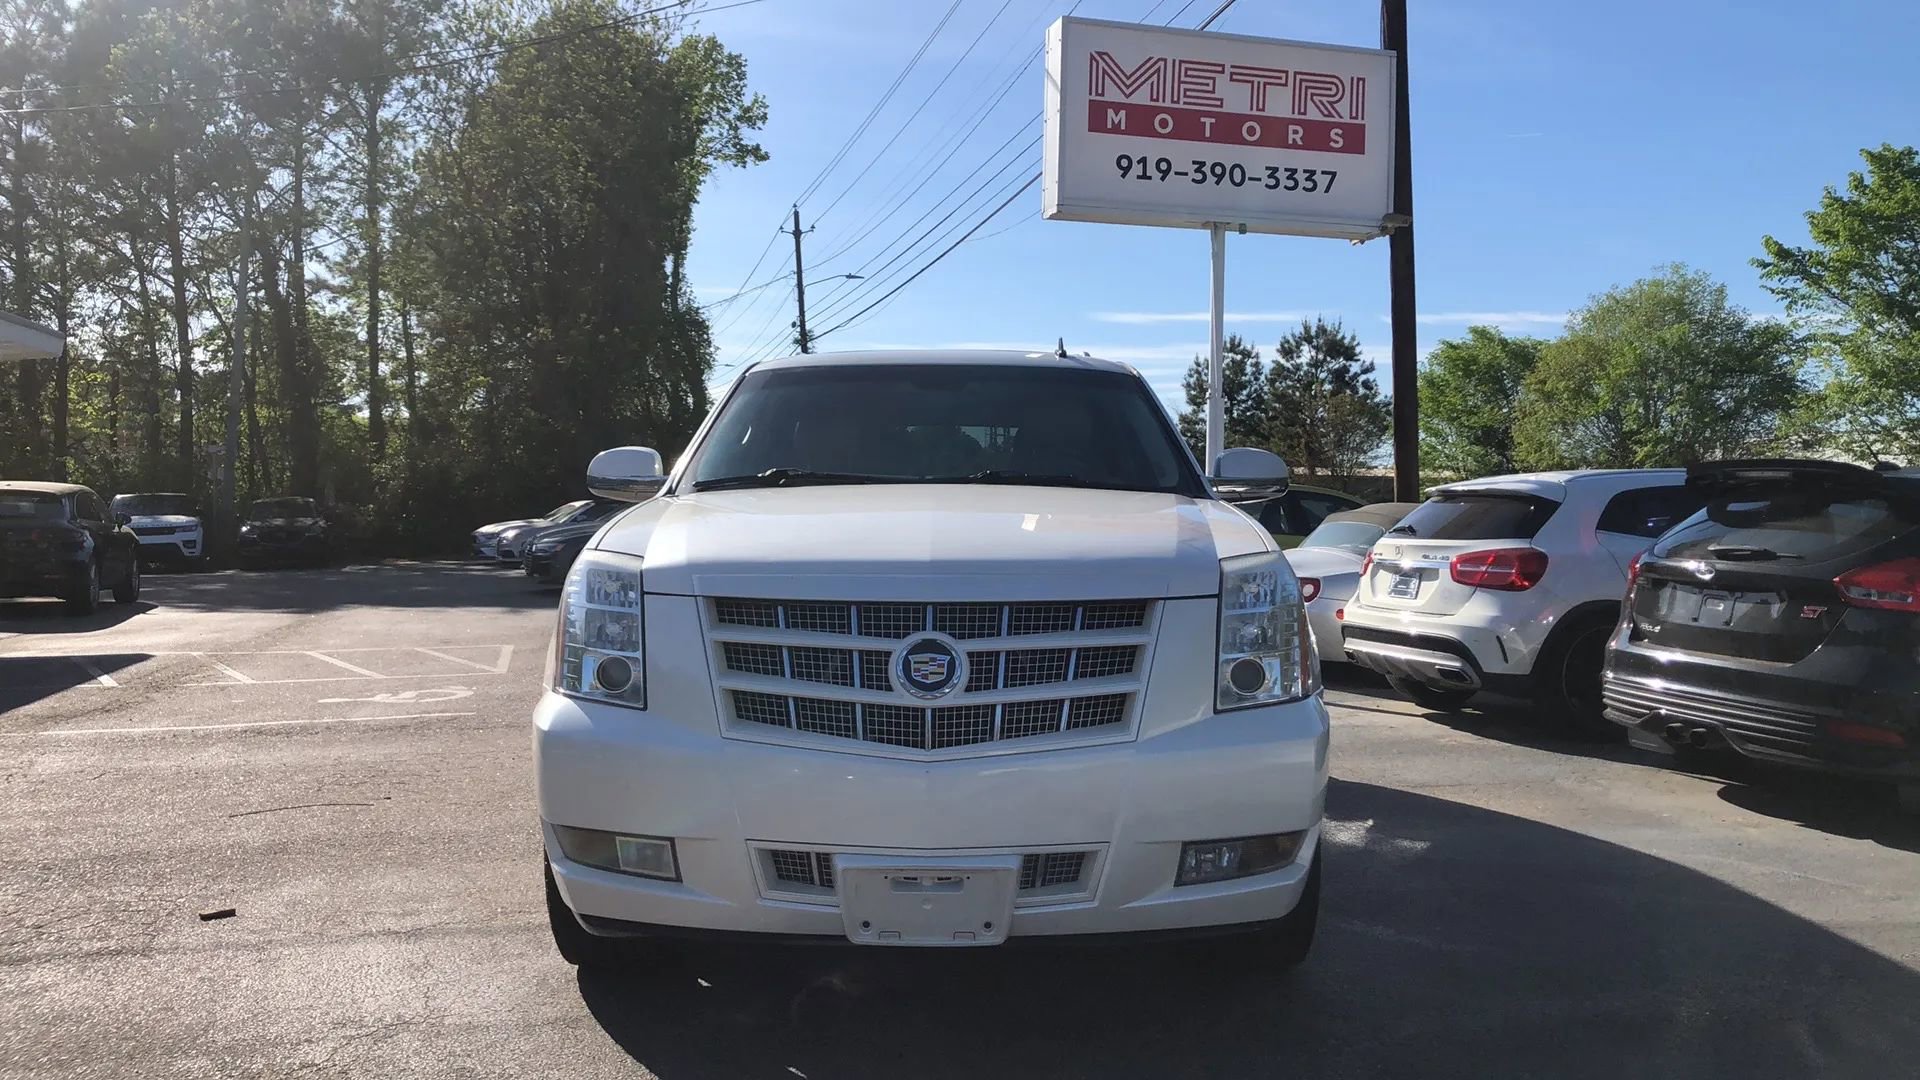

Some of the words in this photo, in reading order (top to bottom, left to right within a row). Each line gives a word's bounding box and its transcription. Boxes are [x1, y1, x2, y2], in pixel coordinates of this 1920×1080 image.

[1088, 51, 1366, 120] METRI
[1106, 108, 1344, 148] MOTORS
[1115, 154, 1337, 193] 919-390-3337
